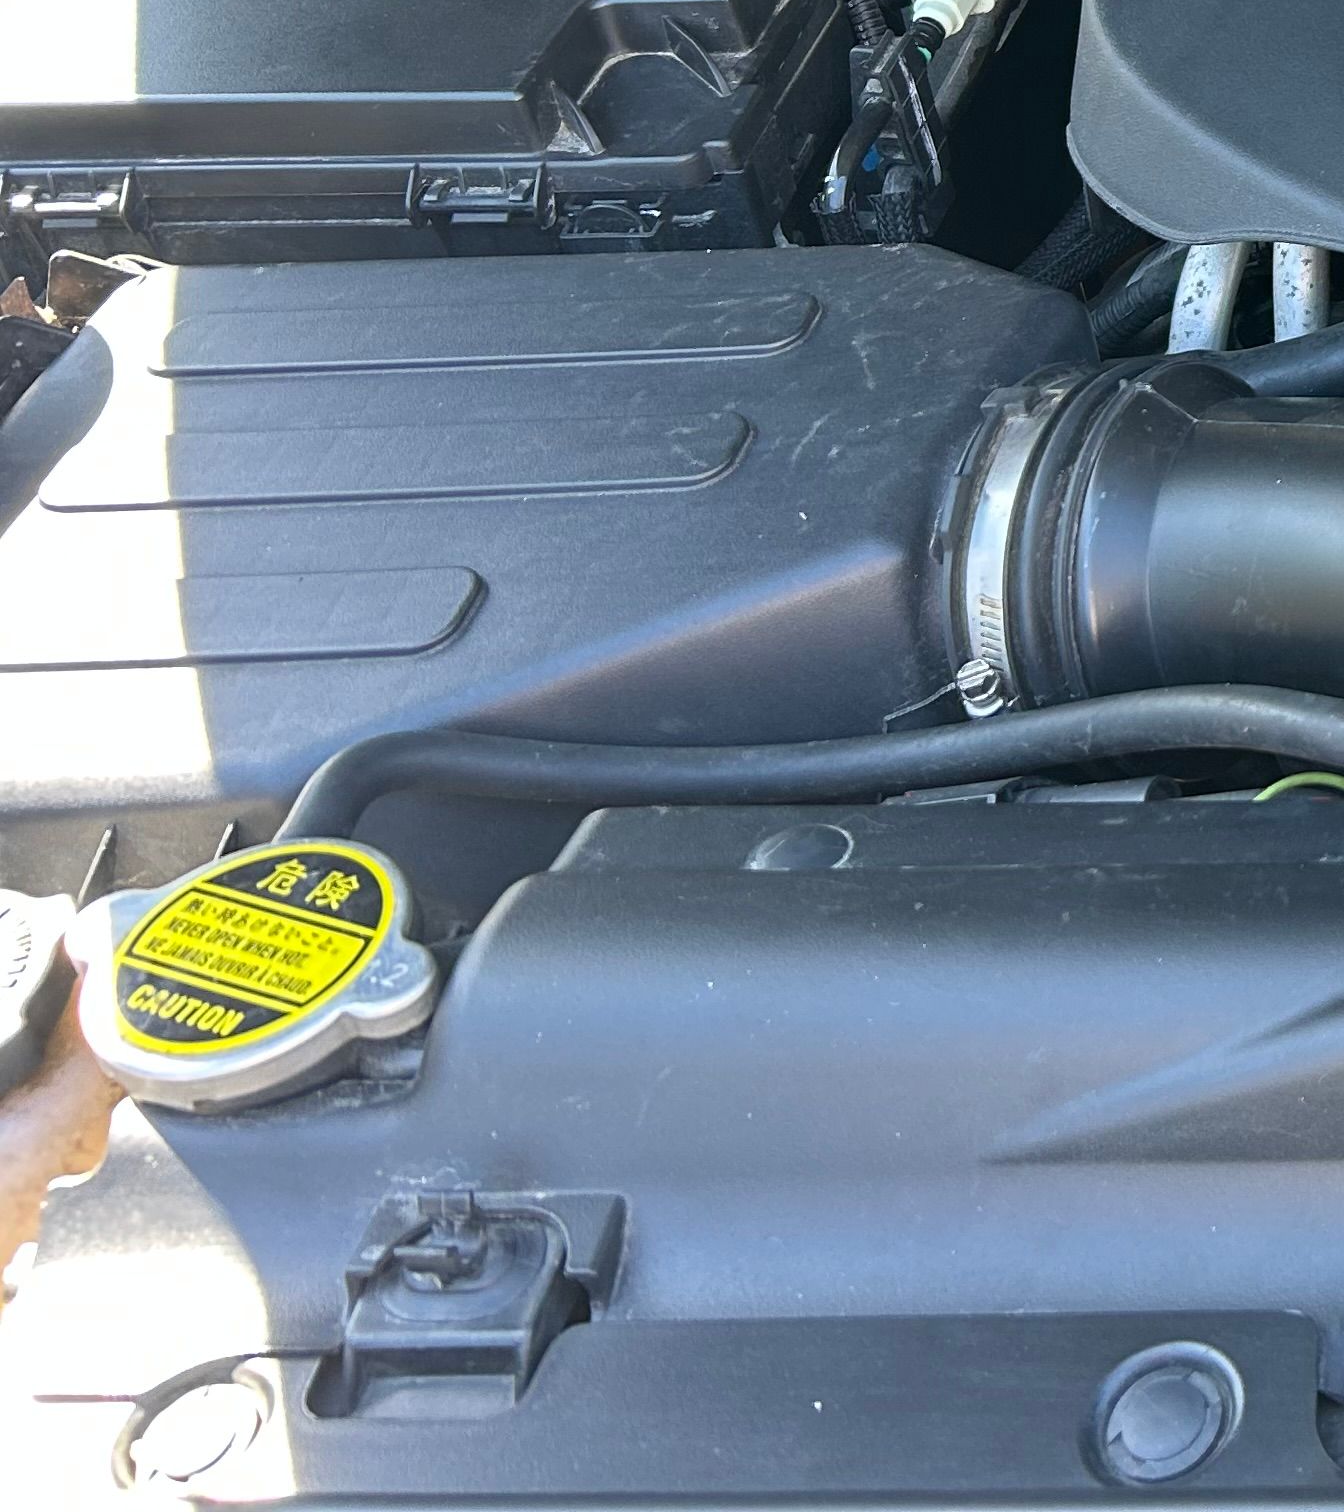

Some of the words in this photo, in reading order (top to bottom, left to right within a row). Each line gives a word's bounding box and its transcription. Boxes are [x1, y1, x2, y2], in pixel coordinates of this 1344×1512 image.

[255, 858, 361, 911] 危険
[144, 936, 163, 952] NE
[160, 941, 210, 966] JAMAIS
[208, 953, 260, 977] OUVRIR
[164, 916, 210, 940] NEVER
[205, 926, 243, 951] OPEN
[242, 935, 282, 960] WHEN
[126, 983, 246, 1038] CAUTION
